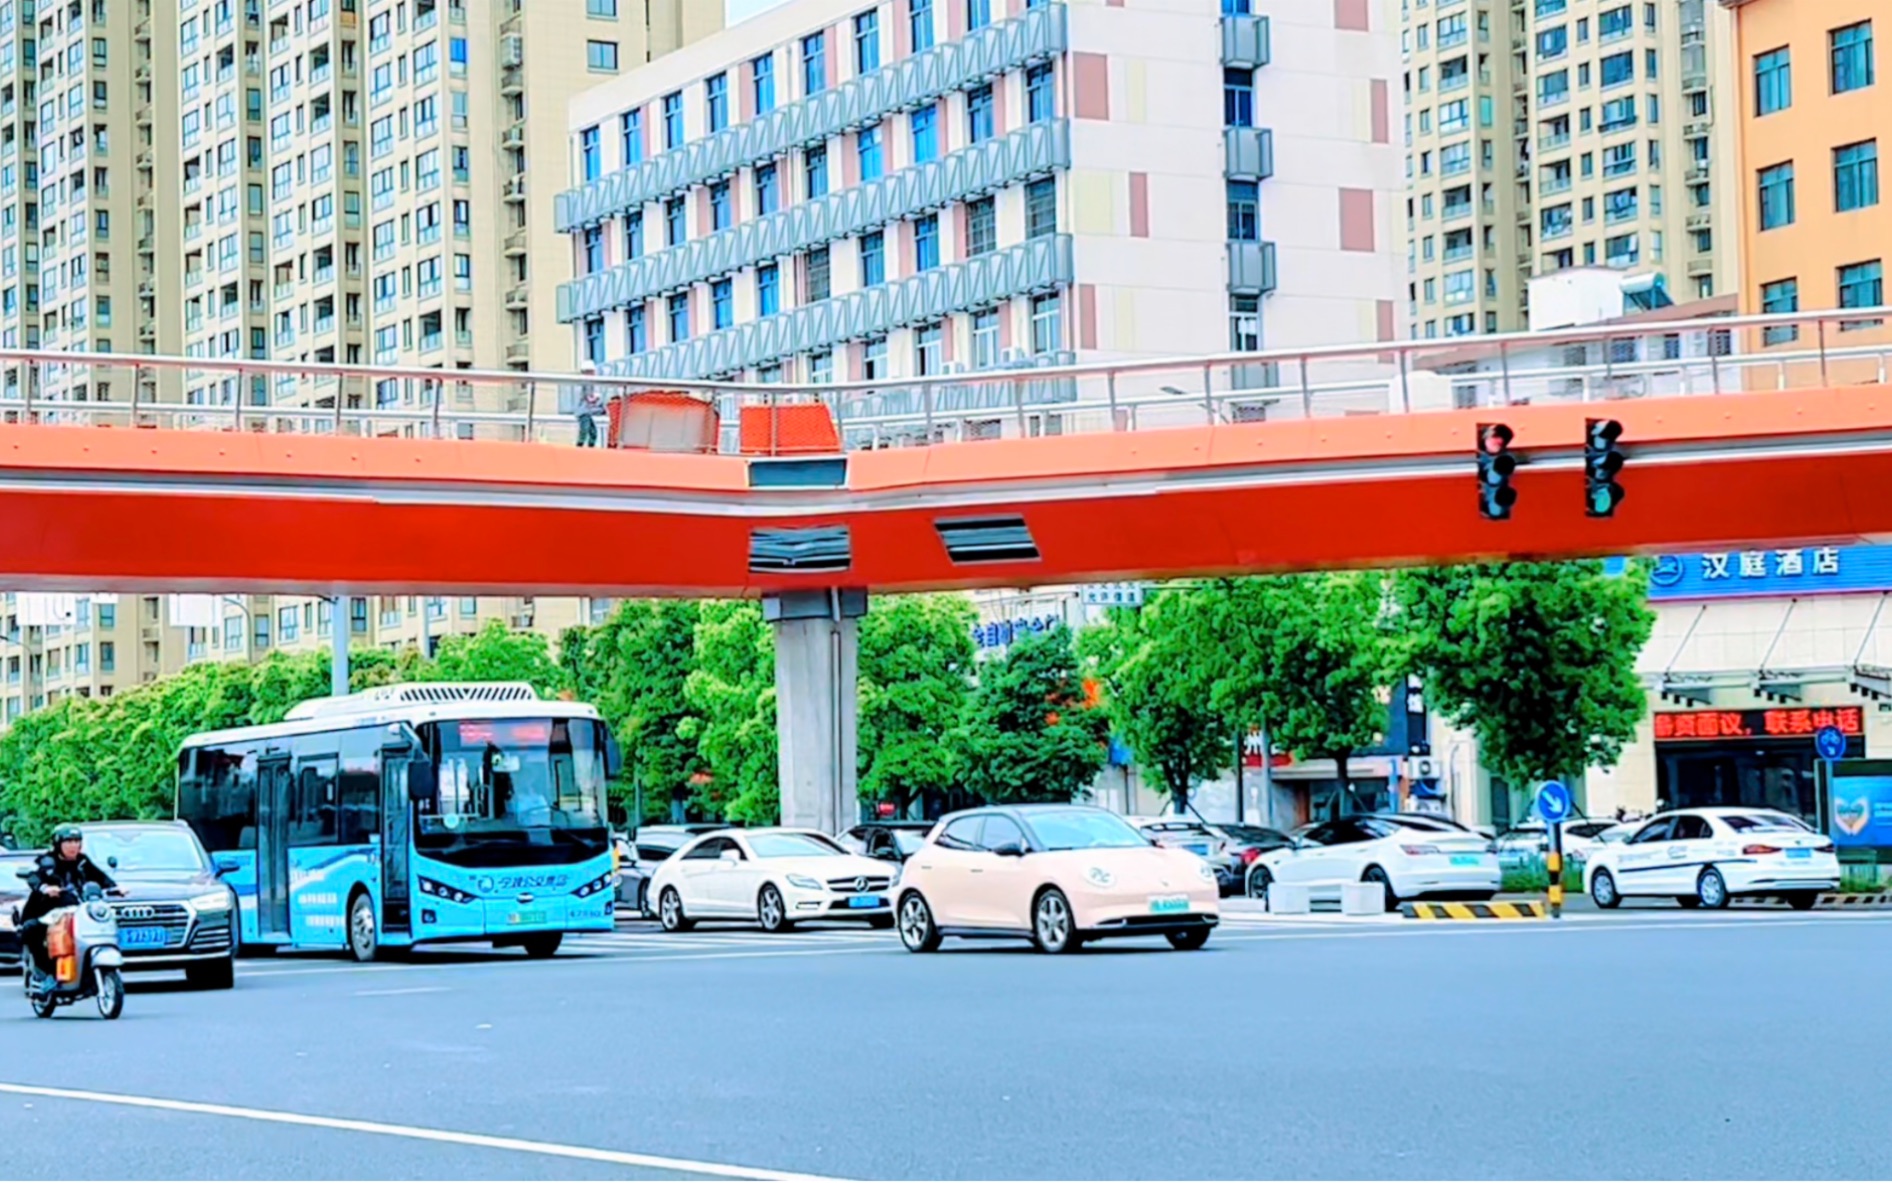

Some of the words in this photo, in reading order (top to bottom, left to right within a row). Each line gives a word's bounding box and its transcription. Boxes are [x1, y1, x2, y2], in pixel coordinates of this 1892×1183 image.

[1702, 547, 1839, 578] 汉庭酒店
[1764, 708, 1859, 736] 联系电话
